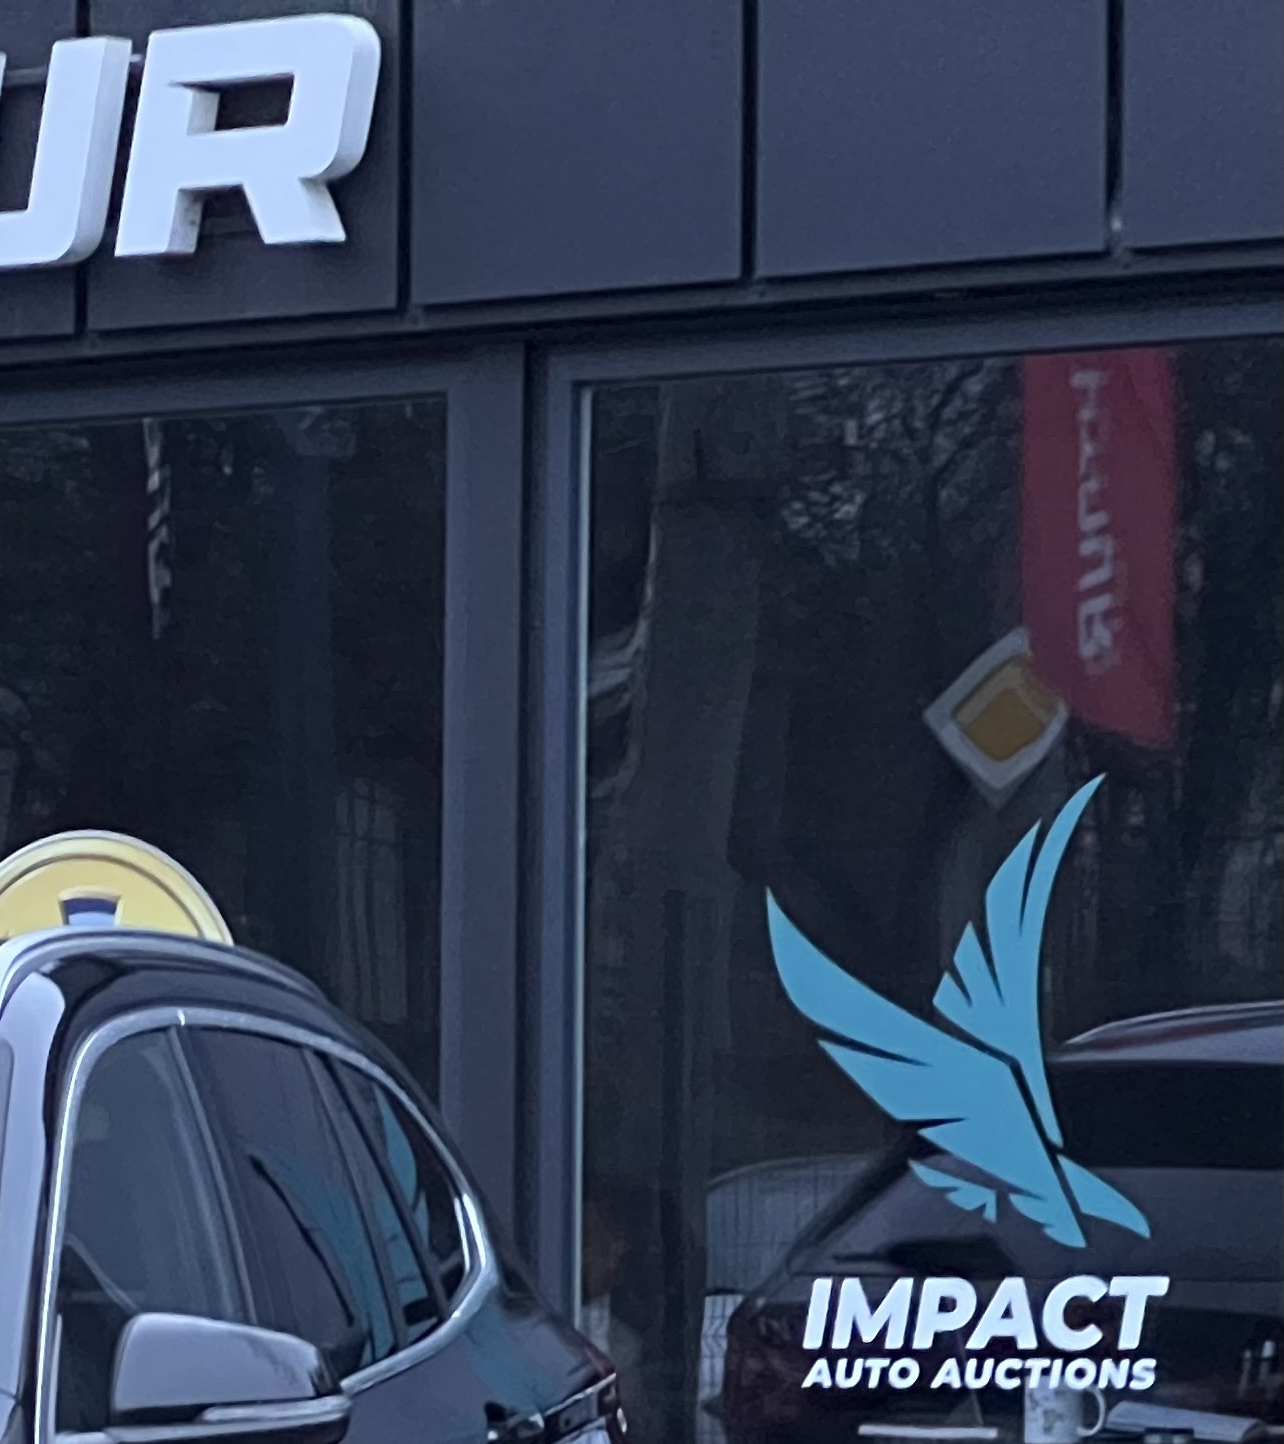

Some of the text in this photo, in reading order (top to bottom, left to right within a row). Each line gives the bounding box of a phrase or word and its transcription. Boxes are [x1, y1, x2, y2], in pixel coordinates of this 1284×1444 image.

[801, 1274, 1171, 1352] IMPACT
[801, 1357, 1157, 1391] AUTO AUCTIONS
